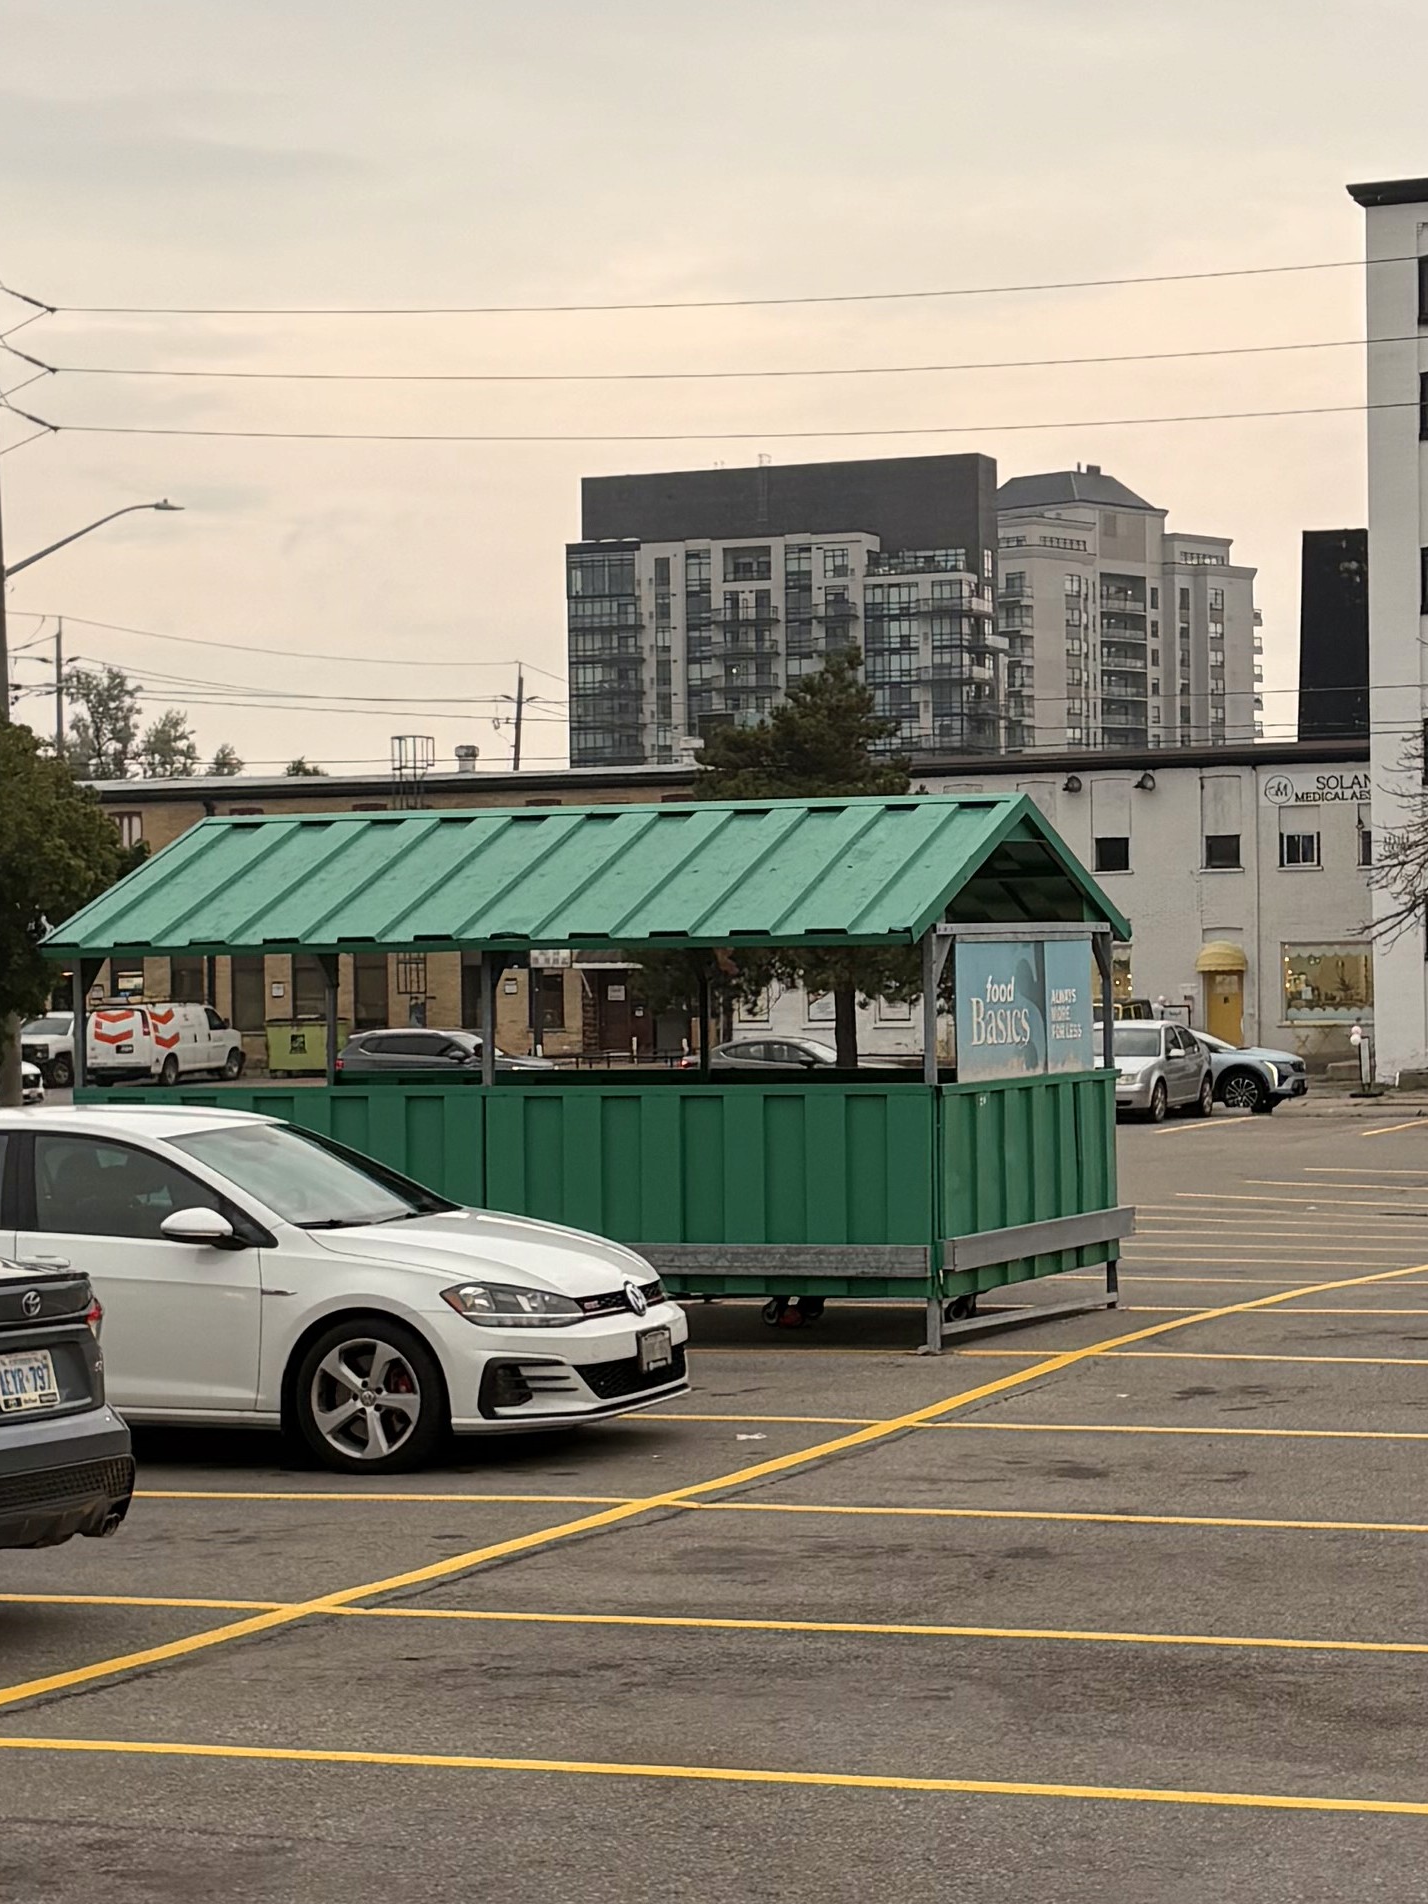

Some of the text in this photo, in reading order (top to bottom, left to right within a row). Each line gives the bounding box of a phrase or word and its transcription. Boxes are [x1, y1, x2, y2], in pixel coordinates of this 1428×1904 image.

[1294, 790, 1348, 802] MEDICAL
[986, 975, 1015, 1003] food
[970, 997, 1031, 1047] Basics
